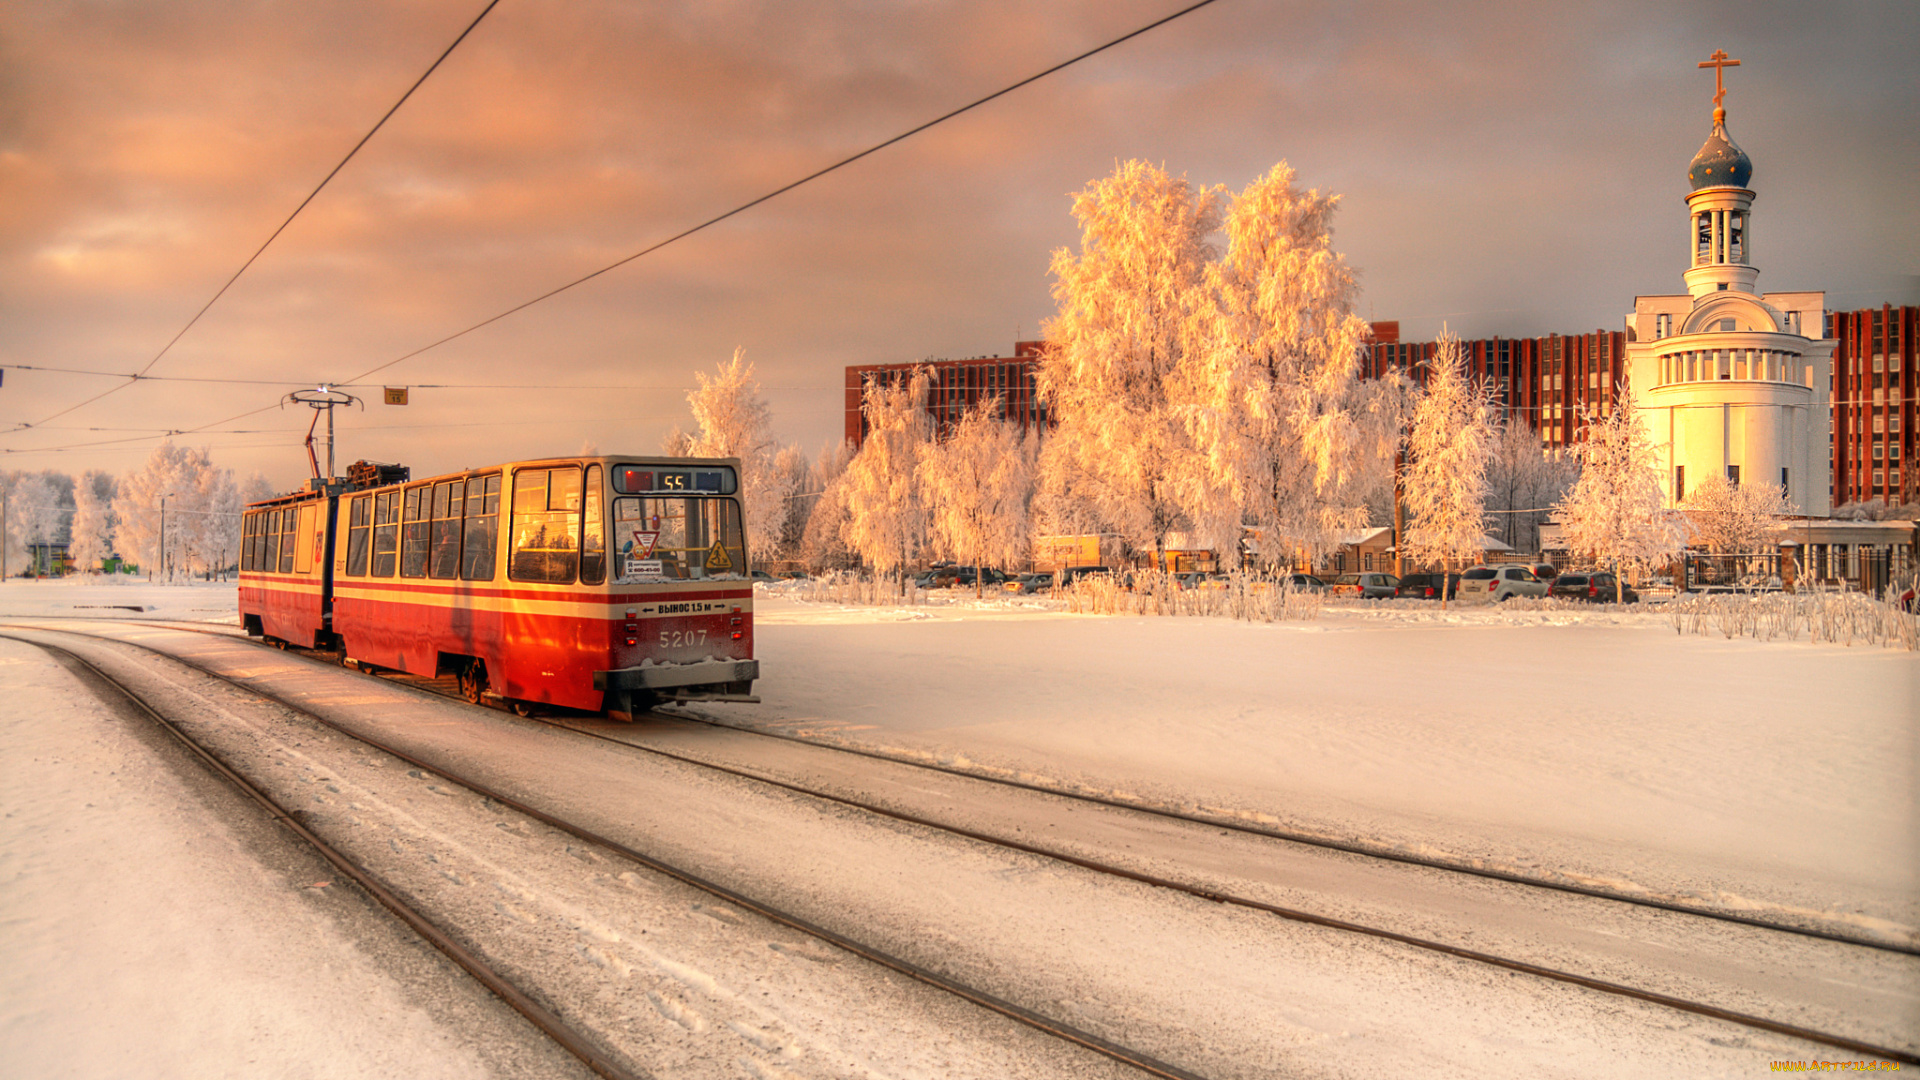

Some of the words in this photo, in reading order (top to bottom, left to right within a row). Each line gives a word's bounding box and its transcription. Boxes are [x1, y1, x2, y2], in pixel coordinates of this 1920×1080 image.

[664, 475, 684, 491] 55
[658, 603, 689, 614] ВЫНОС
[660, 629, 707, 648] 5207
